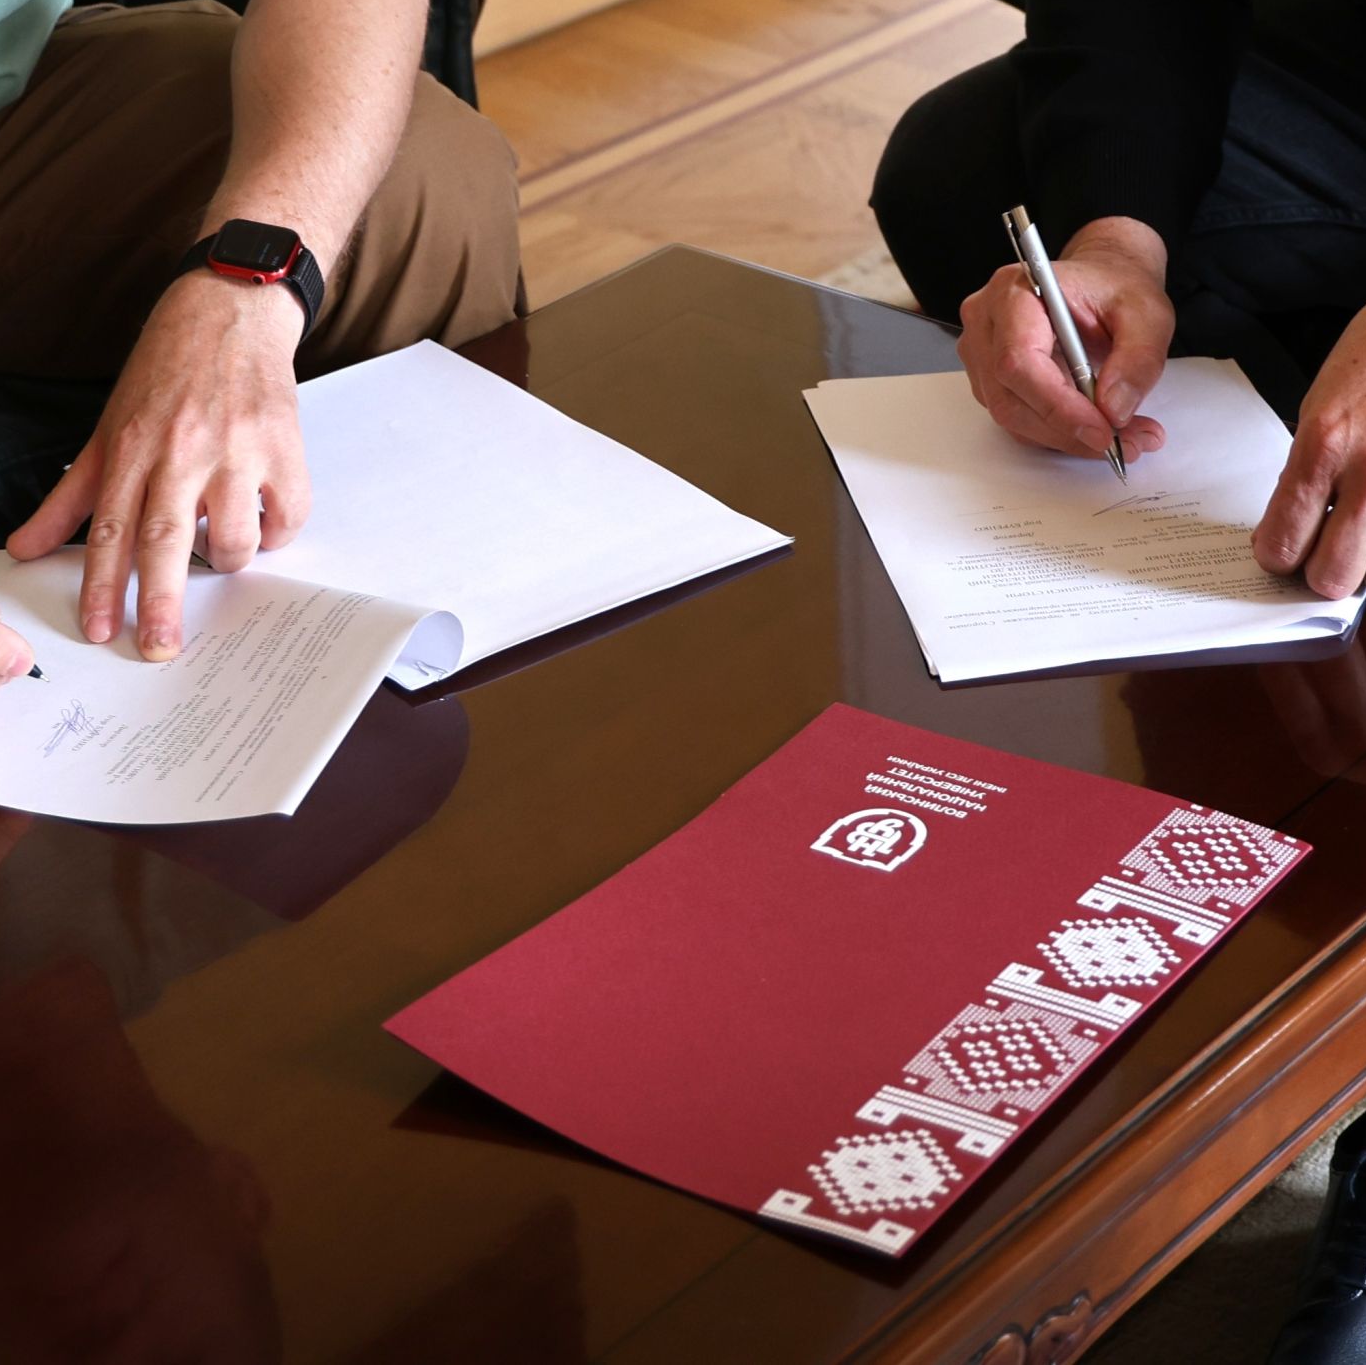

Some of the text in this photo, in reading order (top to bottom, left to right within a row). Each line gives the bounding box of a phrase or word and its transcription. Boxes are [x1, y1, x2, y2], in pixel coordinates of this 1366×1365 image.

[866, 772, 987, 812] НАЦІОНАЛЬНИЙ
[887, 755, 1008, 794] ІМЕНІ ЛЕСІ УКРАЇНКИ
[887, 766, 986, 800] УНІВЕРСИТЕТ
[864, 783, 968, 819] ВОЛИНСЬКИЙ
